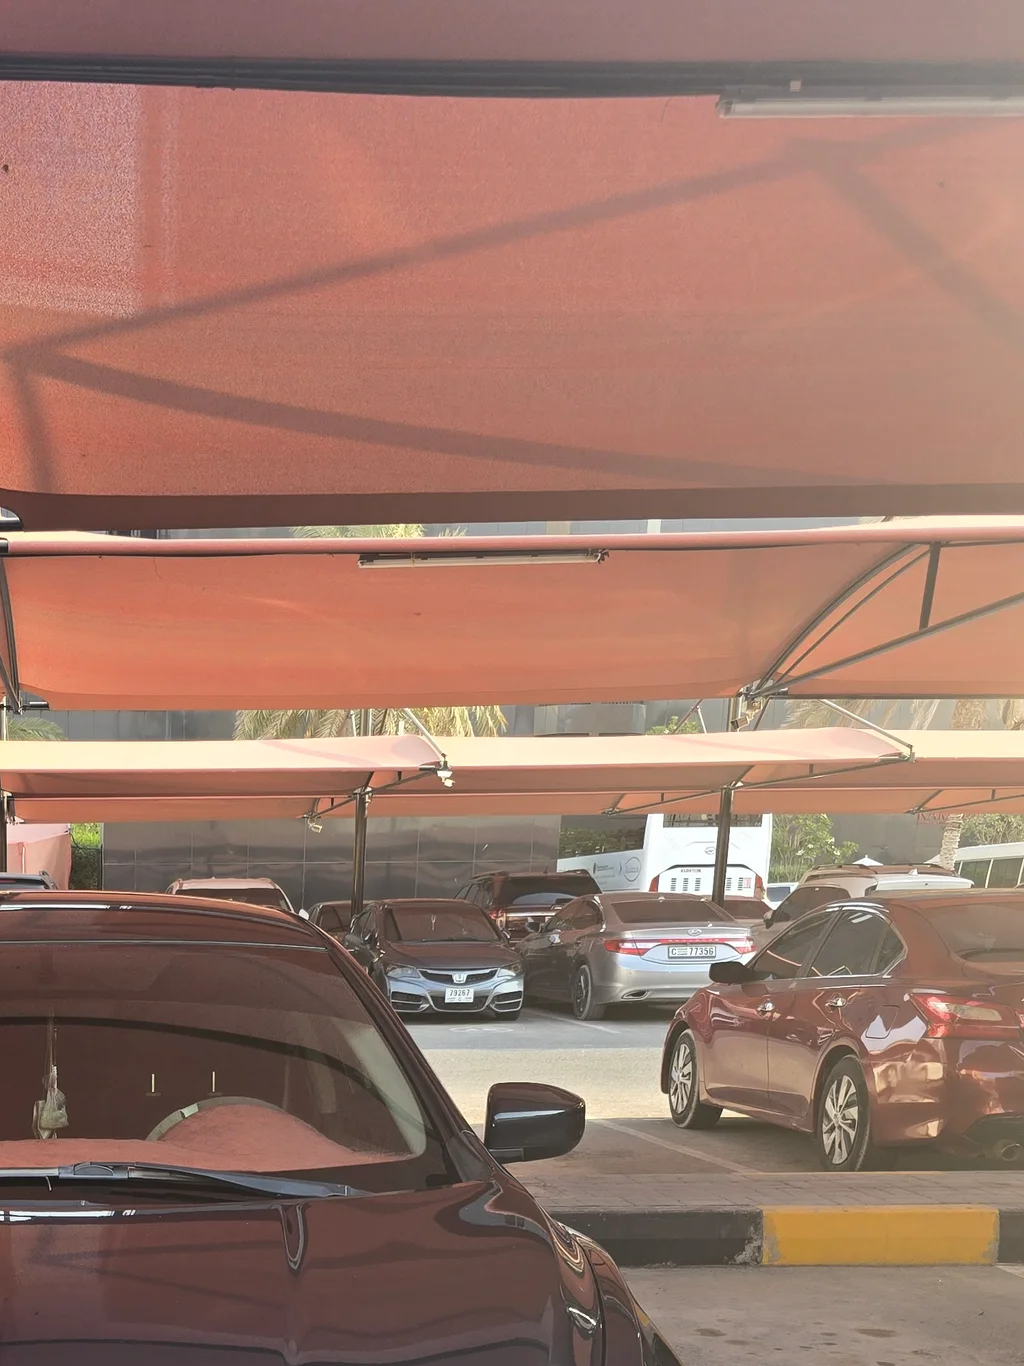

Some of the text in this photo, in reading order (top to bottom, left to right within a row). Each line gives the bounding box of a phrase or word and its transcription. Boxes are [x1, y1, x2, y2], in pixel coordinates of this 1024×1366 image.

[671, 947, 677, 955] C
[689, 947, 714, 955] 77356
[449, 989, 470, 997] 79267
